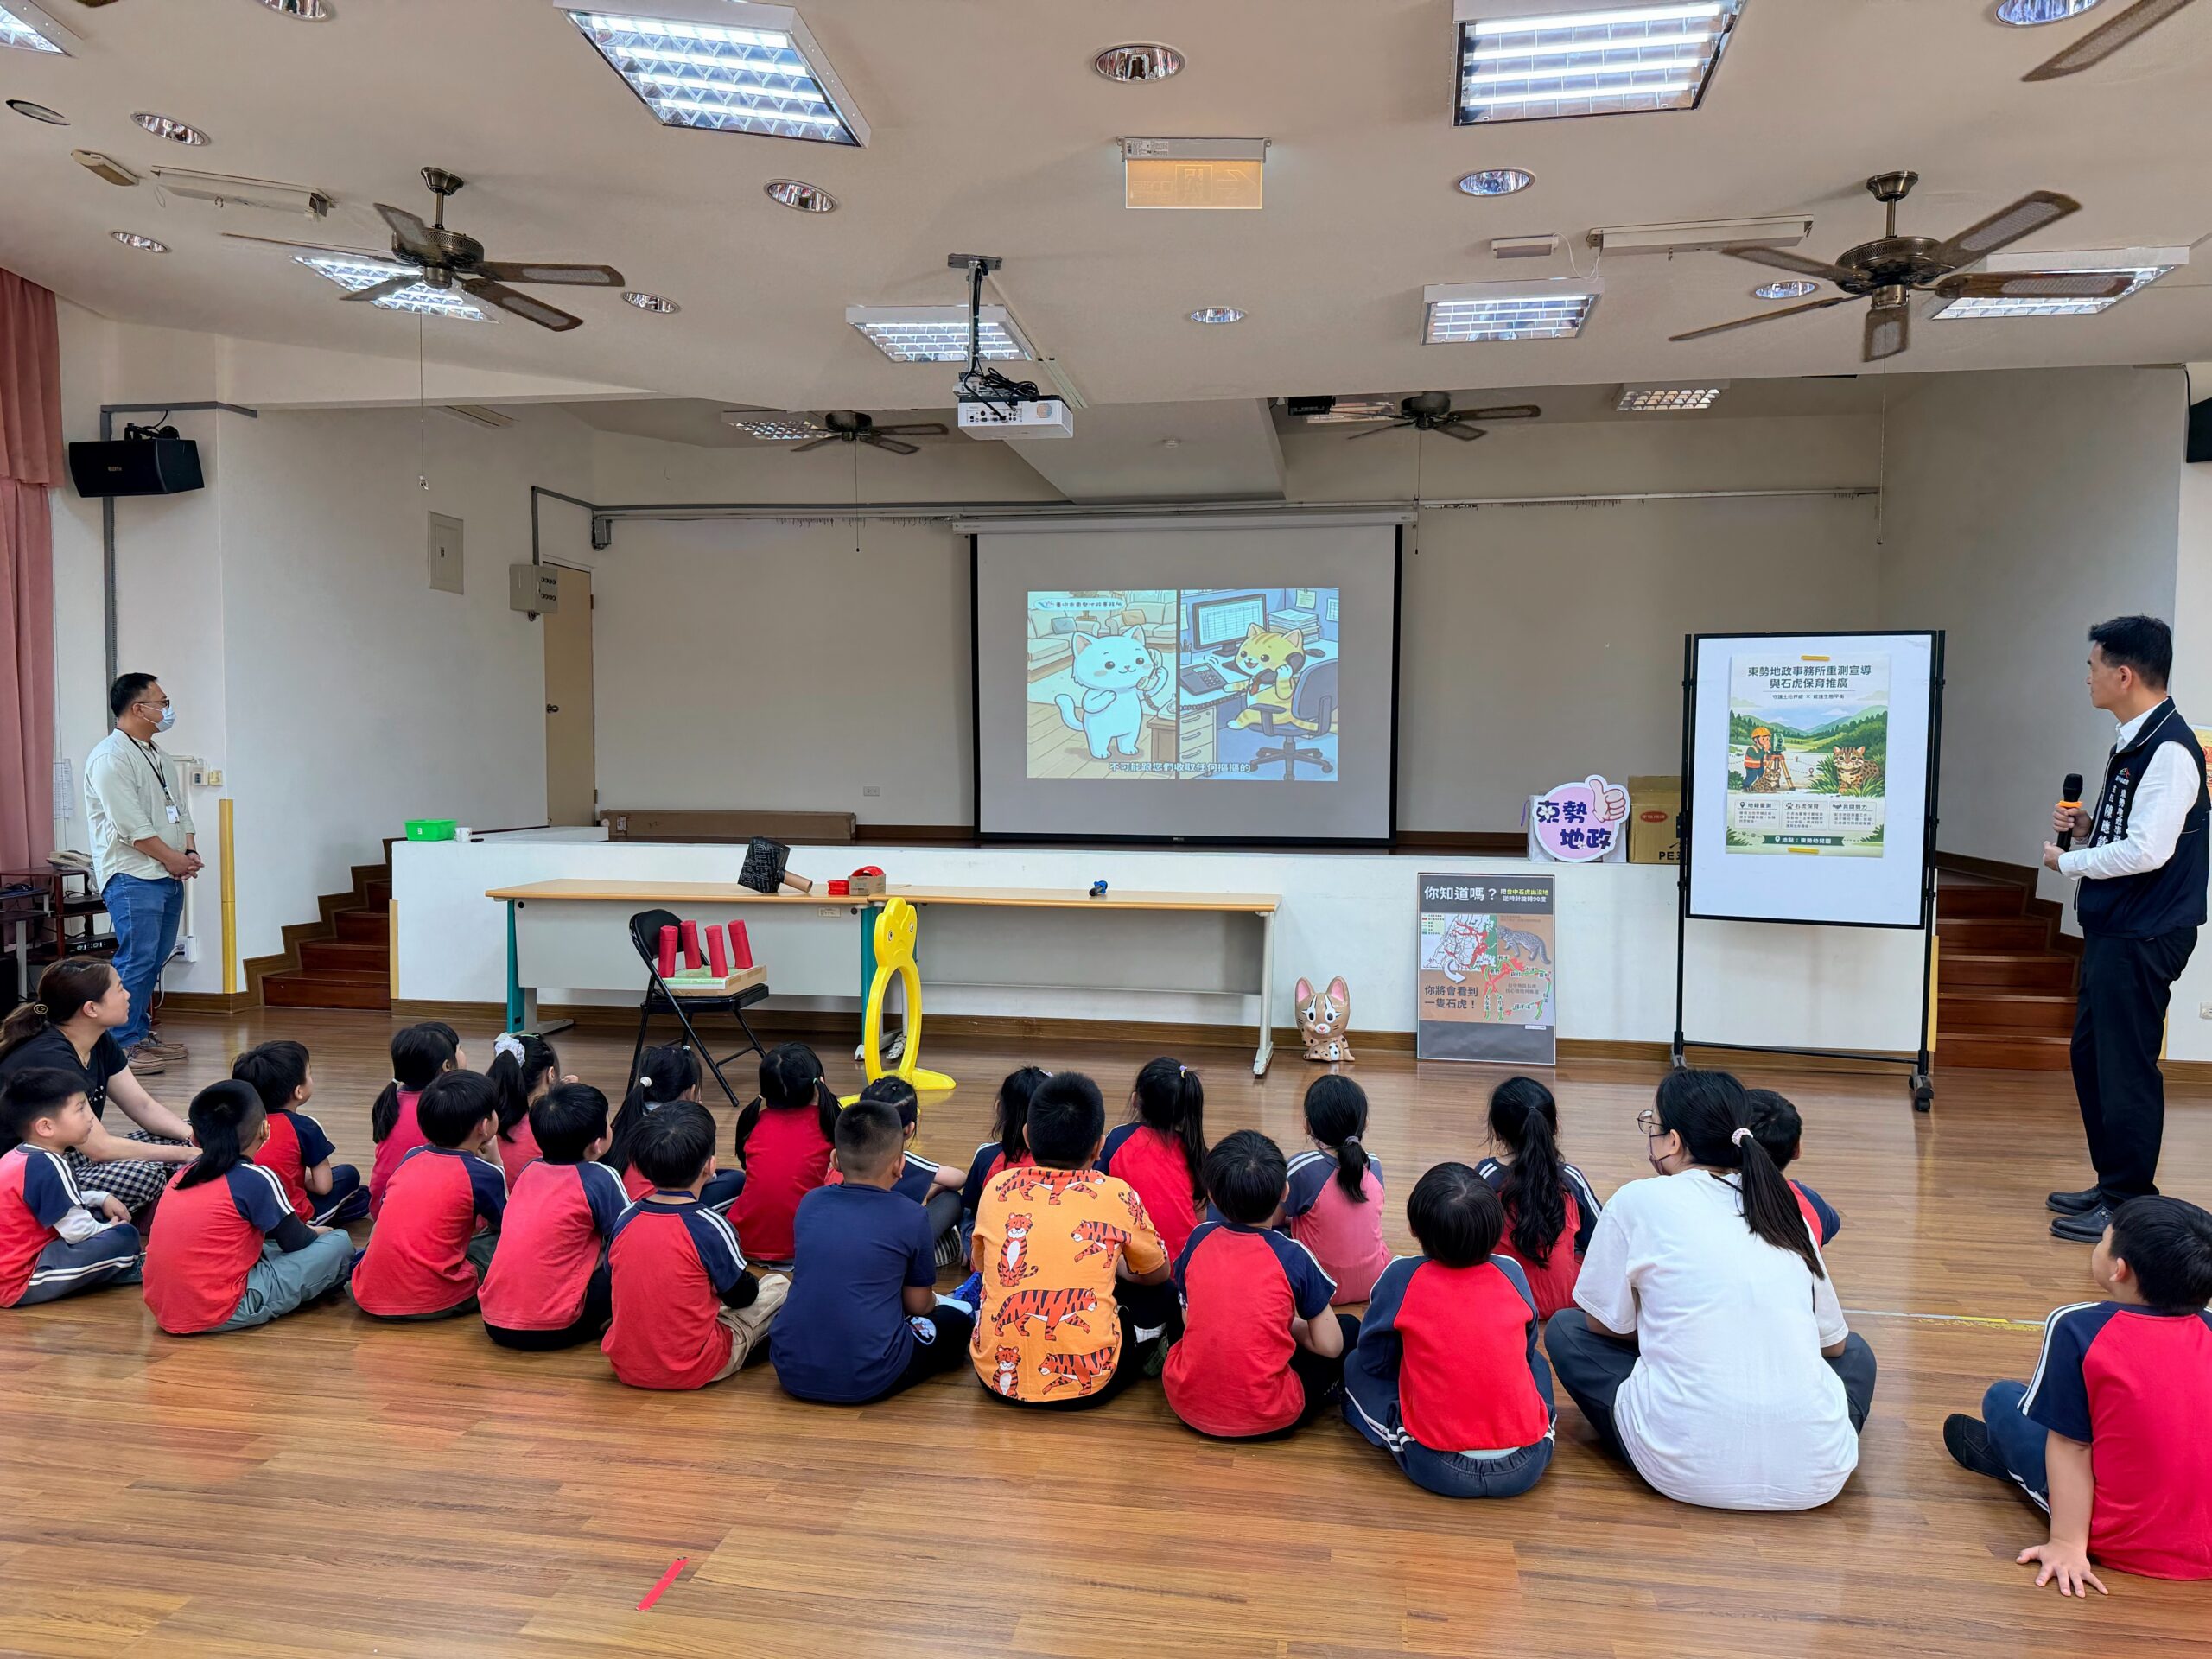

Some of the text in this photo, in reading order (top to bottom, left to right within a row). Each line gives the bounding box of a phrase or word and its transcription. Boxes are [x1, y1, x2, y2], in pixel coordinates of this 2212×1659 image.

[1748, 664, 1872, 677] 東勢地政事務所重測宣導
[1770, 677, 1848, 689] 與石虎保育推廣
[1560, 828, 1612, 849] 地政
[1424, 886, 1497, 901] 你知道嗎？
[1424, 985, 1478, 997] 你將會看到
[1424, 997, 1475, 1009] 一隻石虎！
